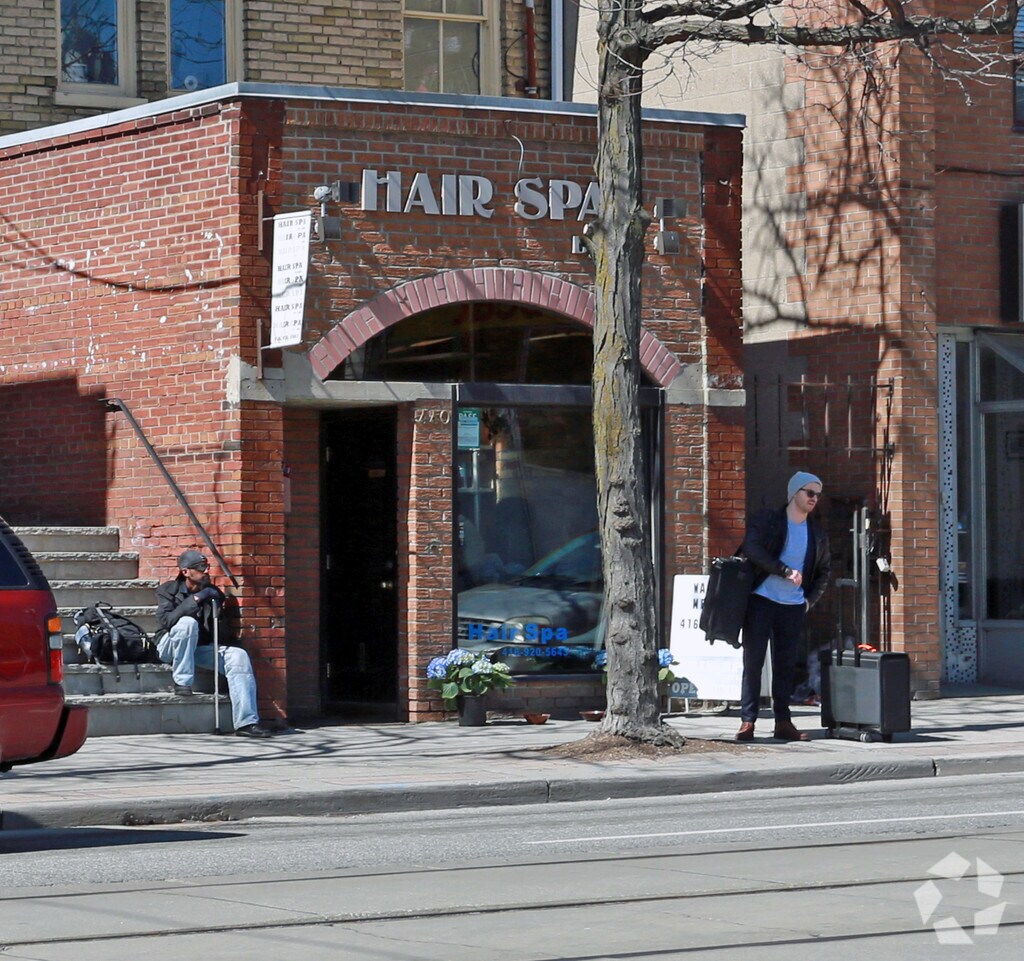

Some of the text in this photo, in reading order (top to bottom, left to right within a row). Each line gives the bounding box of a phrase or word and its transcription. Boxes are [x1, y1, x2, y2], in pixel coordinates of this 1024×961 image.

[360, 168, 600, 221] HAIR SPA
[467, 623, 569, 645] Hair Spa
[671, 682, 696, 695] OPE
